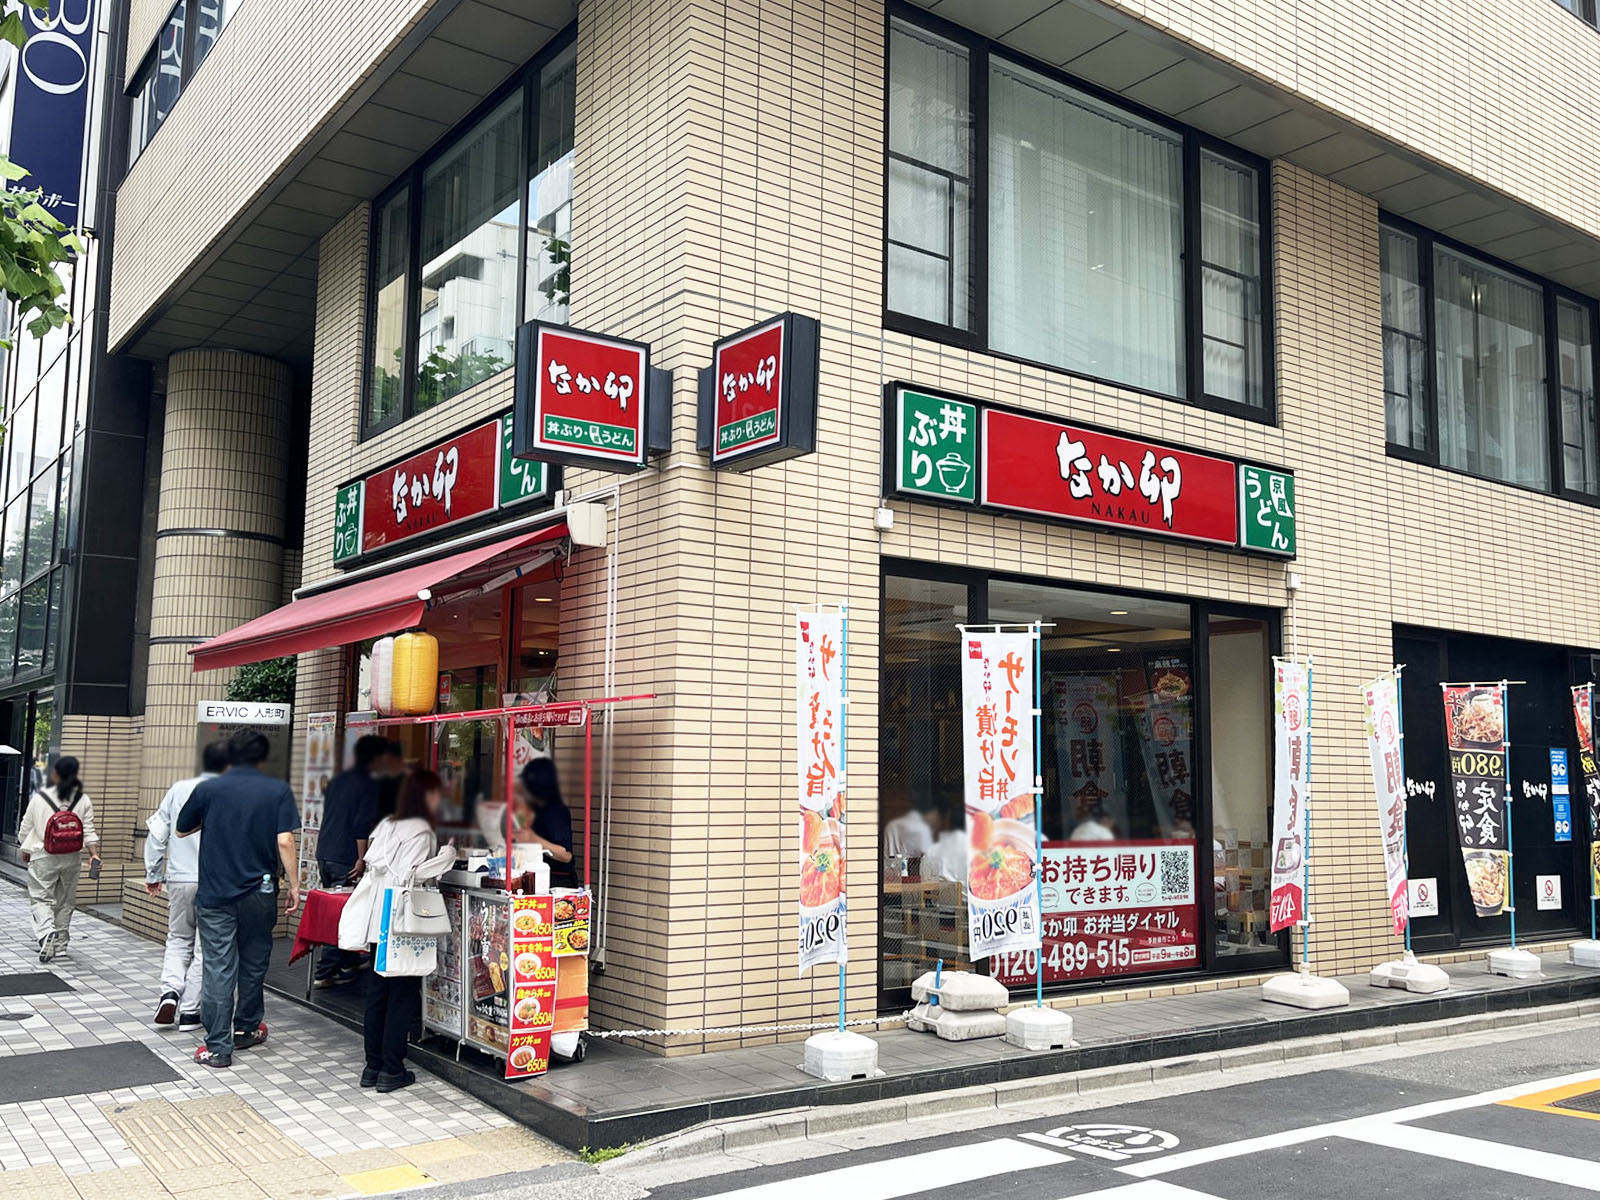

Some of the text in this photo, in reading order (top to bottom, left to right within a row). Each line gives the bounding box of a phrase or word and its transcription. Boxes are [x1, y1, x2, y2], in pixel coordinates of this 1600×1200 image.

[8, 186, 77, 208] サボー
[548, 359, 634, 412] なか卯
[722, 355, 776, 402] なか卯
[392, 446, 459, 525] なか卯
[1056, 431, 1183, 529] なか卯
[1091, 501, 1150, 524] NAKAU
[1244, 469, 1289, 550] うどん
[206, 706, 285, 719] ERVIC 人形町
[1041, 853, 1156, 884] お持ち帰り
[1065, 884, 1130, 905] できます。
[1084, 911, 1180, 935] お弁当ダイヤル
[989, 937, 1130, 978] 0120-489-515
